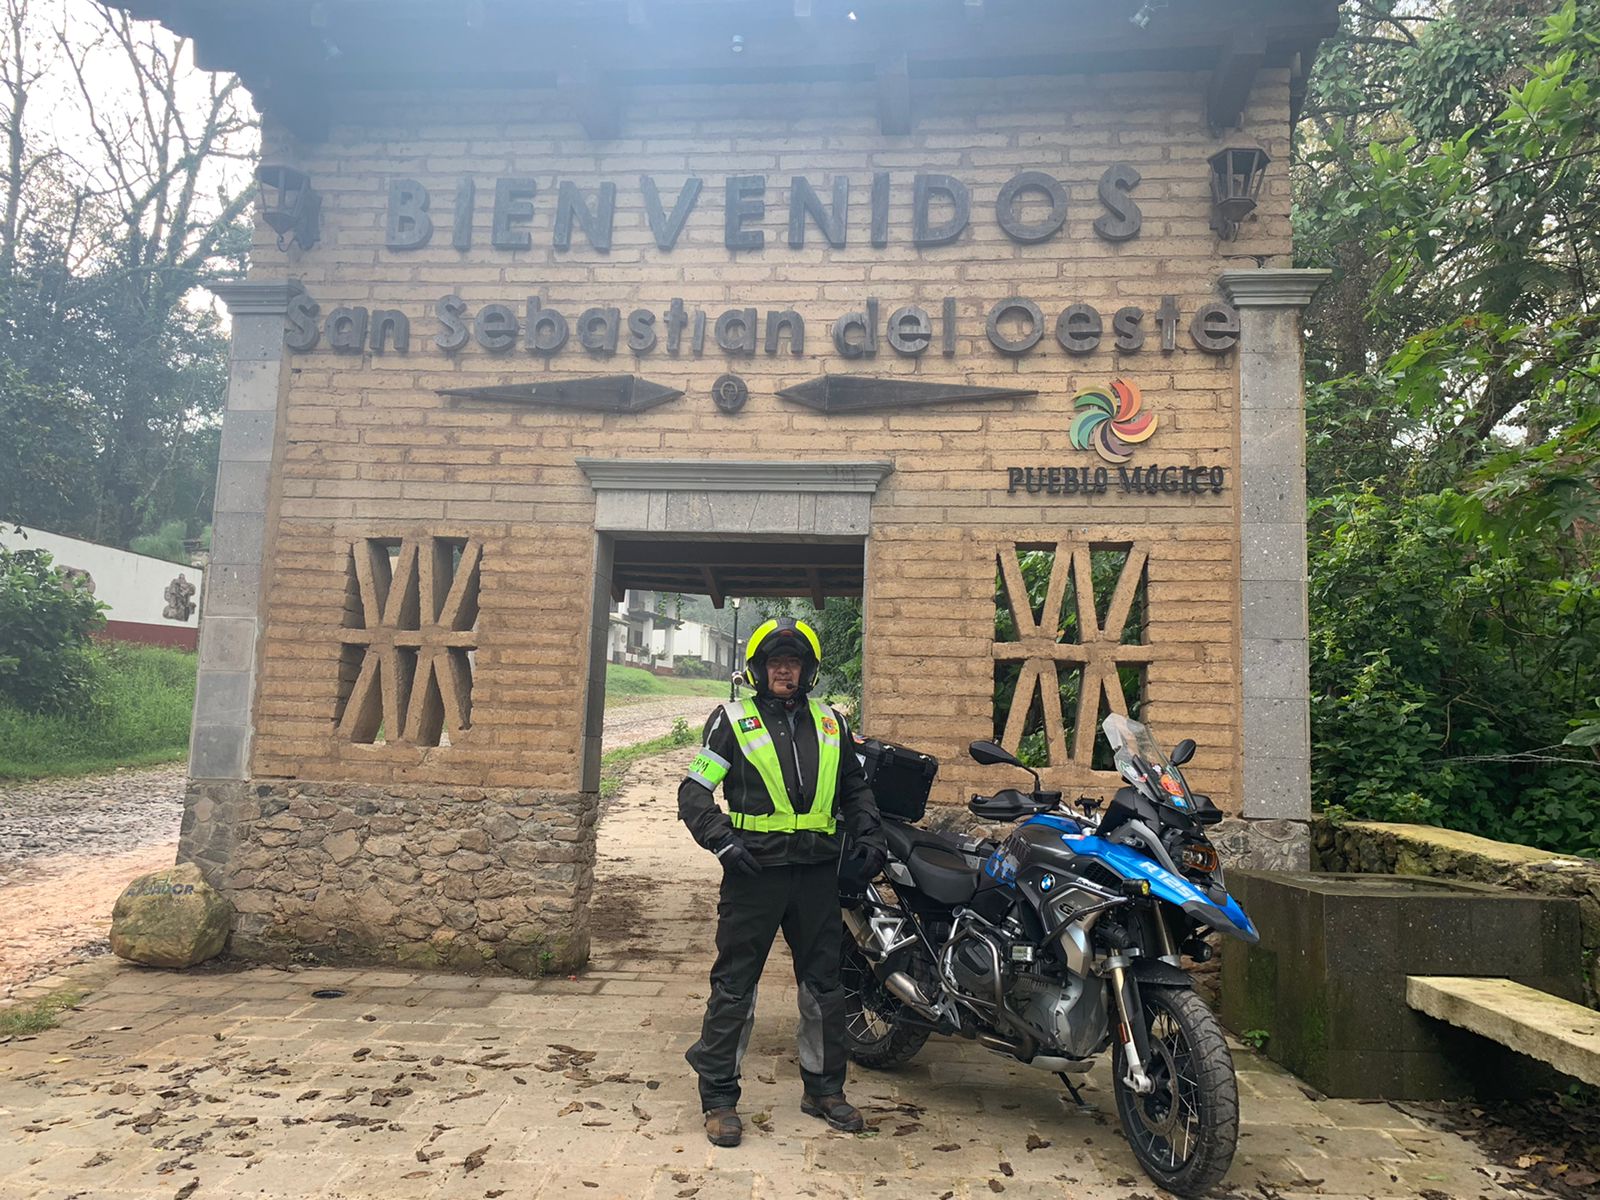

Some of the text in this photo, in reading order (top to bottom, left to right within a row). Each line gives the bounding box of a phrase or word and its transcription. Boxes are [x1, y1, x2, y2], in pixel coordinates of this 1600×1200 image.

[385, 163, 1143, 253] BIENVENIDOS
[284, 294, 411, 355] San
[832, 297, 957, 358] del
[985, 294, 1241, 355] Oeste
[1007, 467, 1108, 494] PUEBLO
